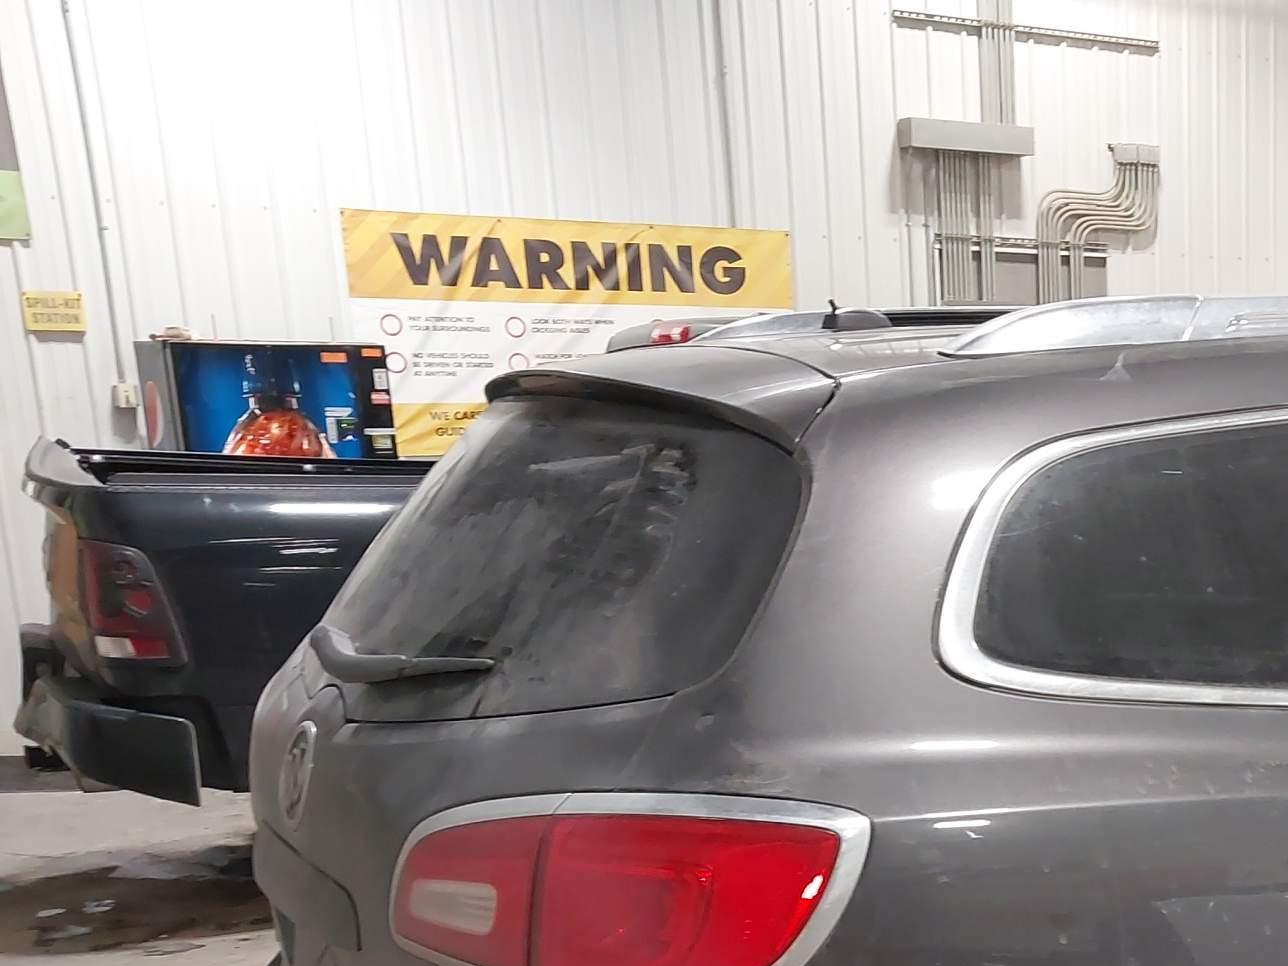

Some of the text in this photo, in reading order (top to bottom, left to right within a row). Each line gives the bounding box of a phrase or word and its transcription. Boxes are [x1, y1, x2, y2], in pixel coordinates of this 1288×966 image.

[390, 232, 746, 295] WARNING
[32, 312, 81, 324] STATION
[429, 411, 450, 421] WE
